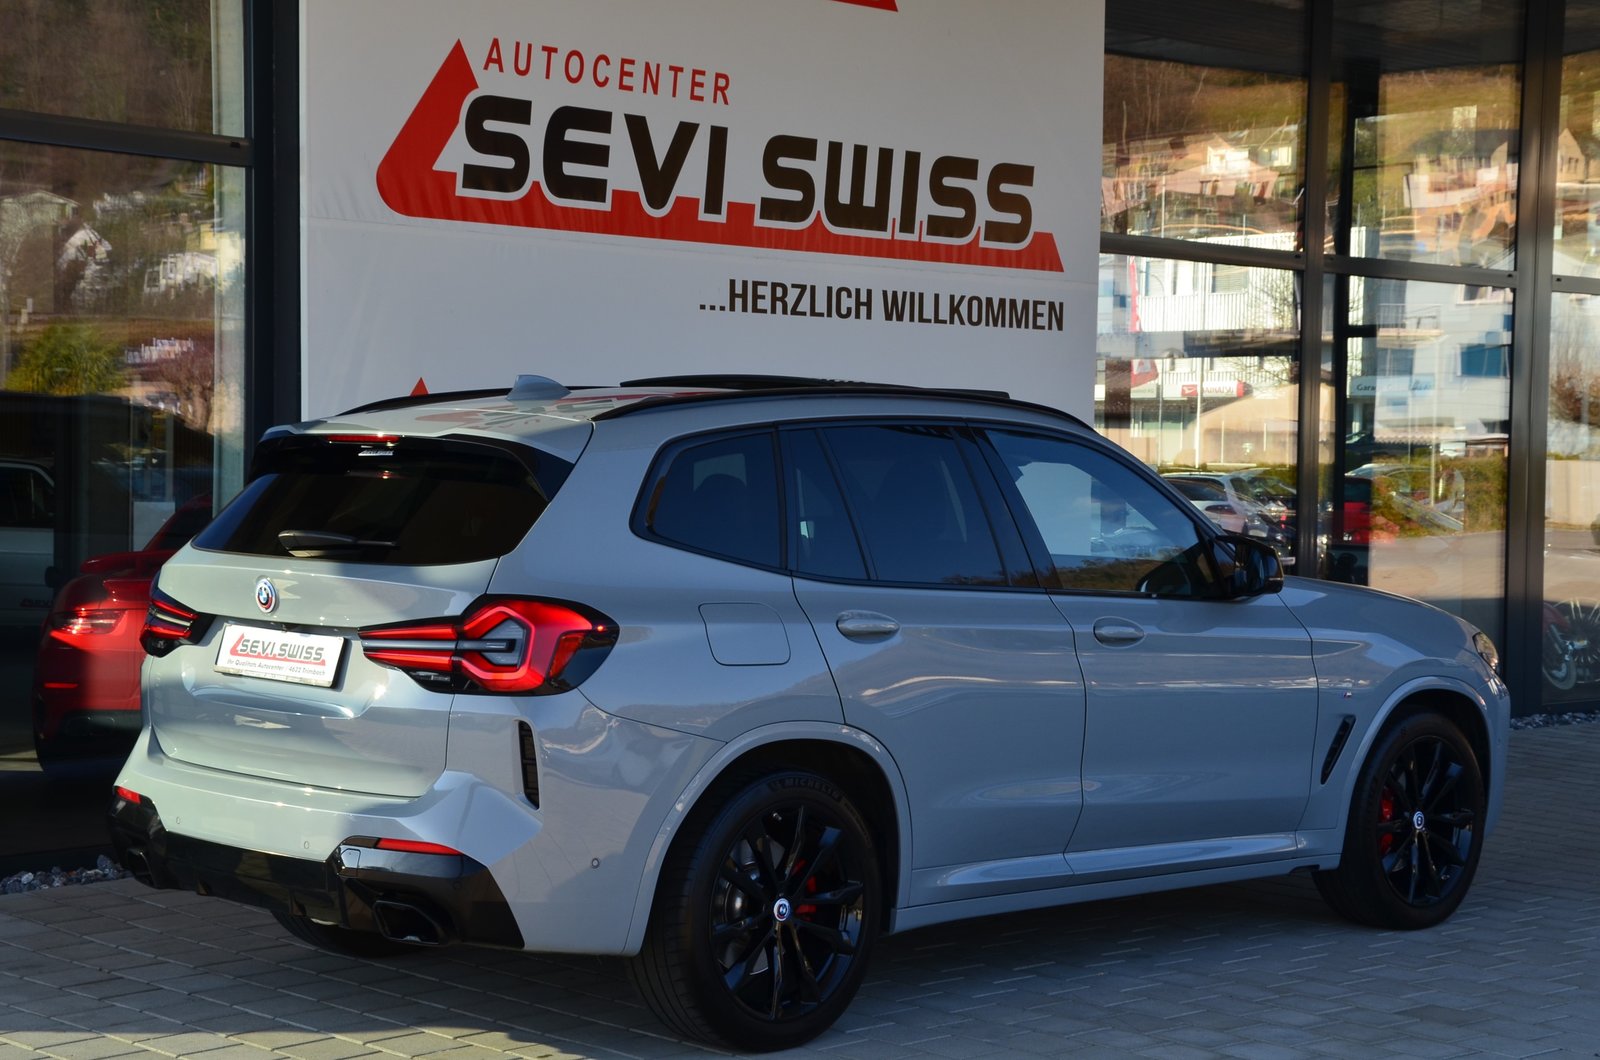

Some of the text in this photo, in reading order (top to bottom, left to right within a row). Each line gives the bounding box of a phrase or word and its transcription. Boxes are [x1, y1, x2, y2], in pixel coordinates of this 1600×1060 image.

[482, 37, 731, 105] AUTOCENTER
[461, 94, 1035, 245] SEVI SWISS
[882, 289, 1065, 331] WILLKOMMEN
[240, 639, 325, 661] SEVI SWISS
